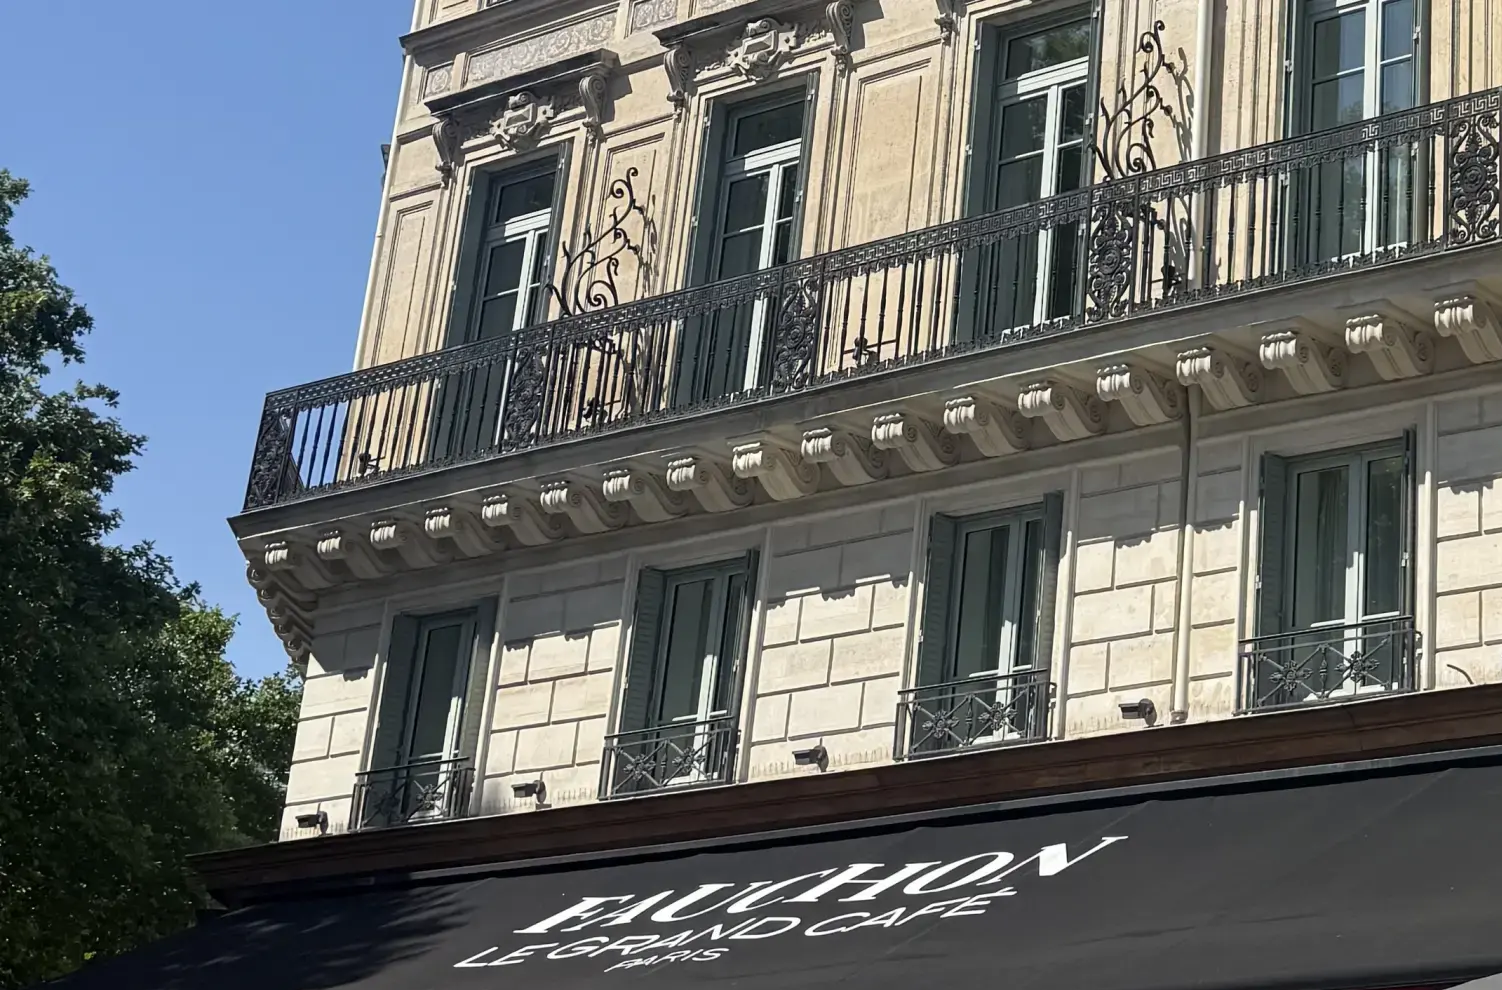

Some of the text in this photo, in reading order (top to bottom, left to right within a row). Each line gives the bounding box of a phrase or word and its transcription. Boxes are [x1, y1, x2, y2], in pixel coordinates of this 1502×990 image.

[513, 836, 1128, 934] FAUCHON
[453, 887, 1018, 968] LE GRAND CAFÉ
[604, 947, 730, 972] PARIS
